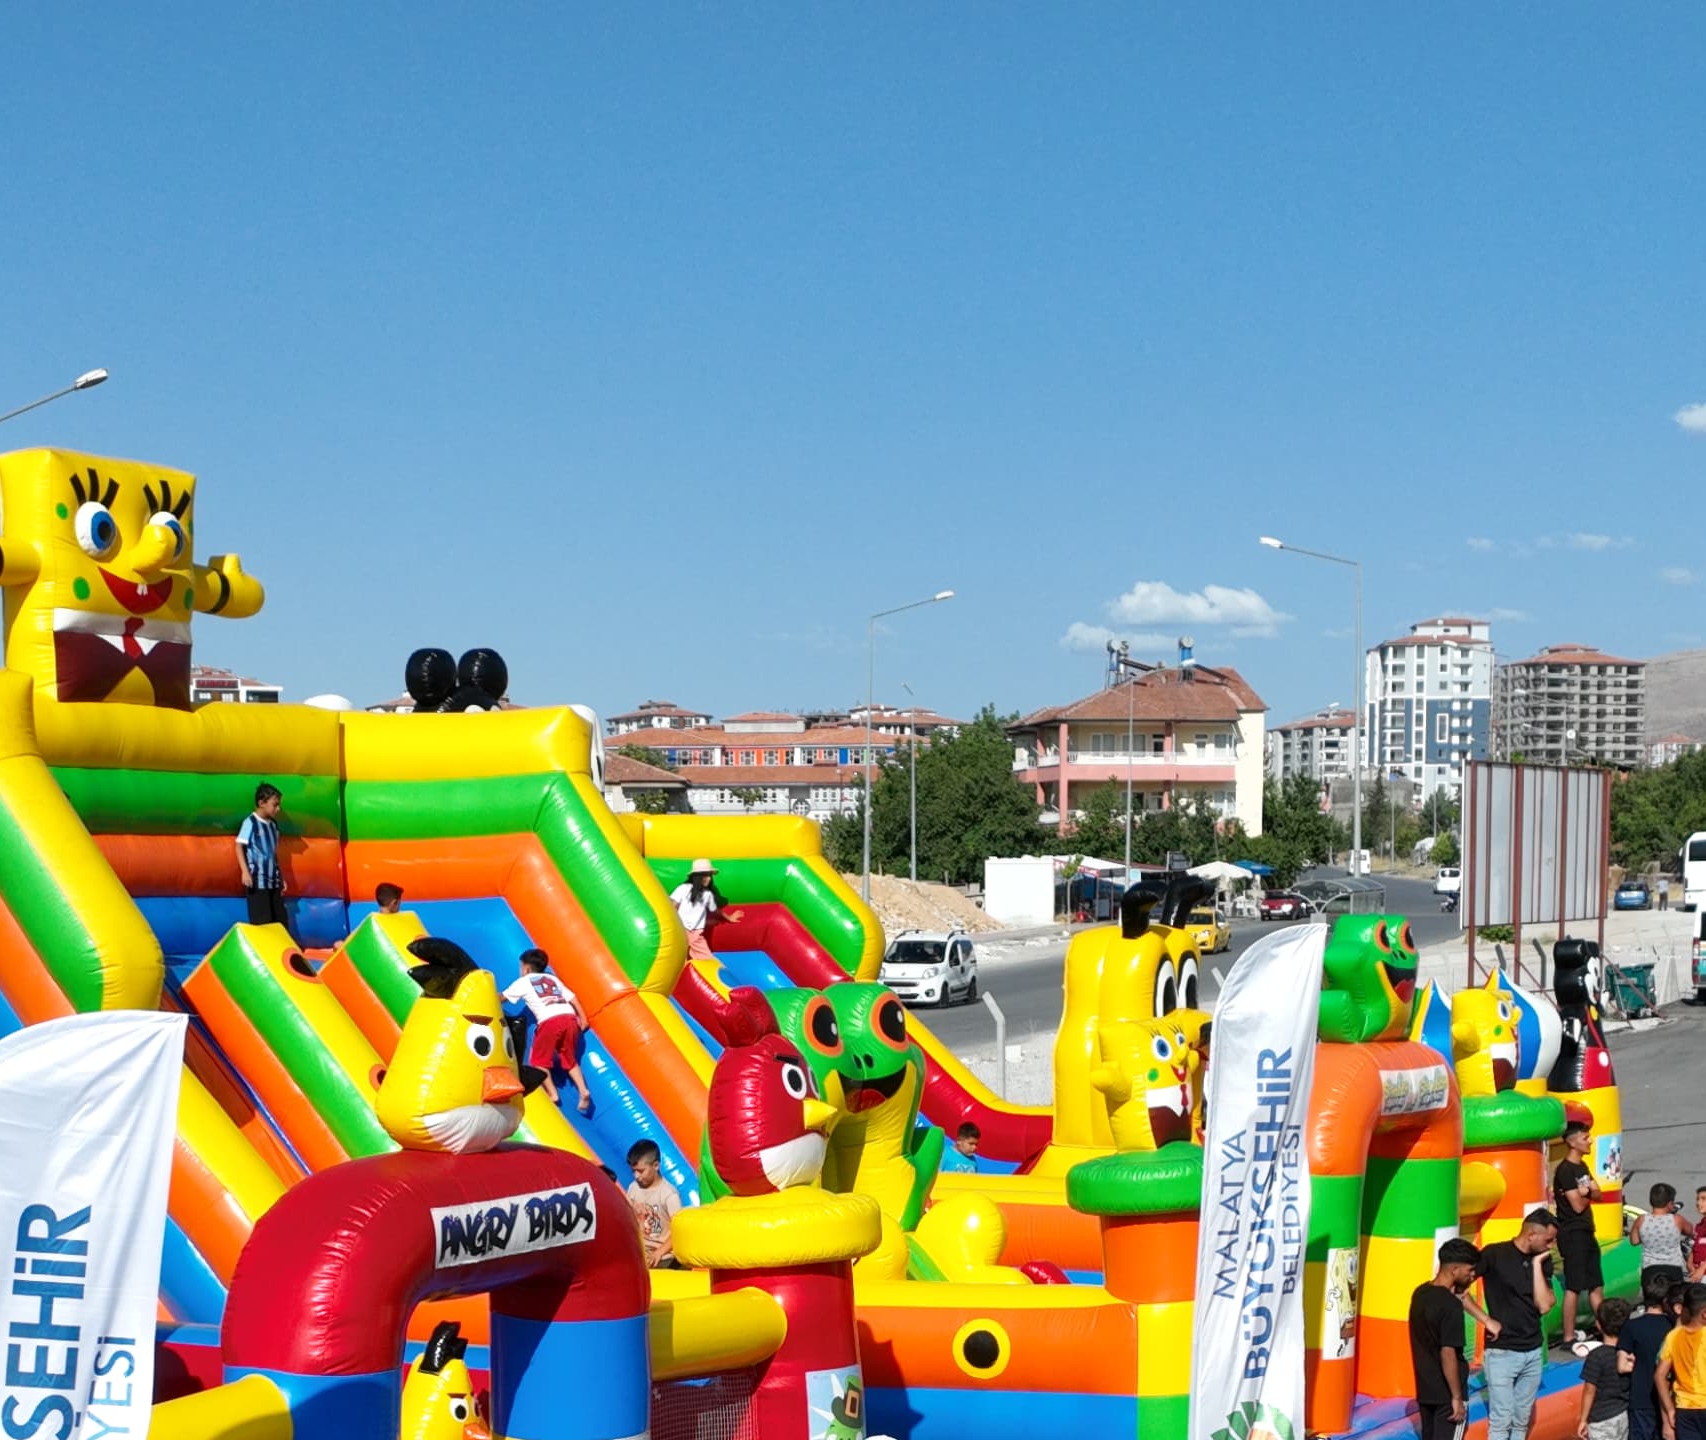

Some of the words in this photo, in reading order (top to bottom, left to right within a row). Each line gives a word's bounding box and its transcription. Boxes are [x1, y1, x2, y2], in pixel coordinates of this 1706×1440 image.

[440, 1202, 519, 1262] ANGRY
[524, 1187, 593, 1242] BIRDS
[1212, 1128, 1248, 1300] MALATYA
